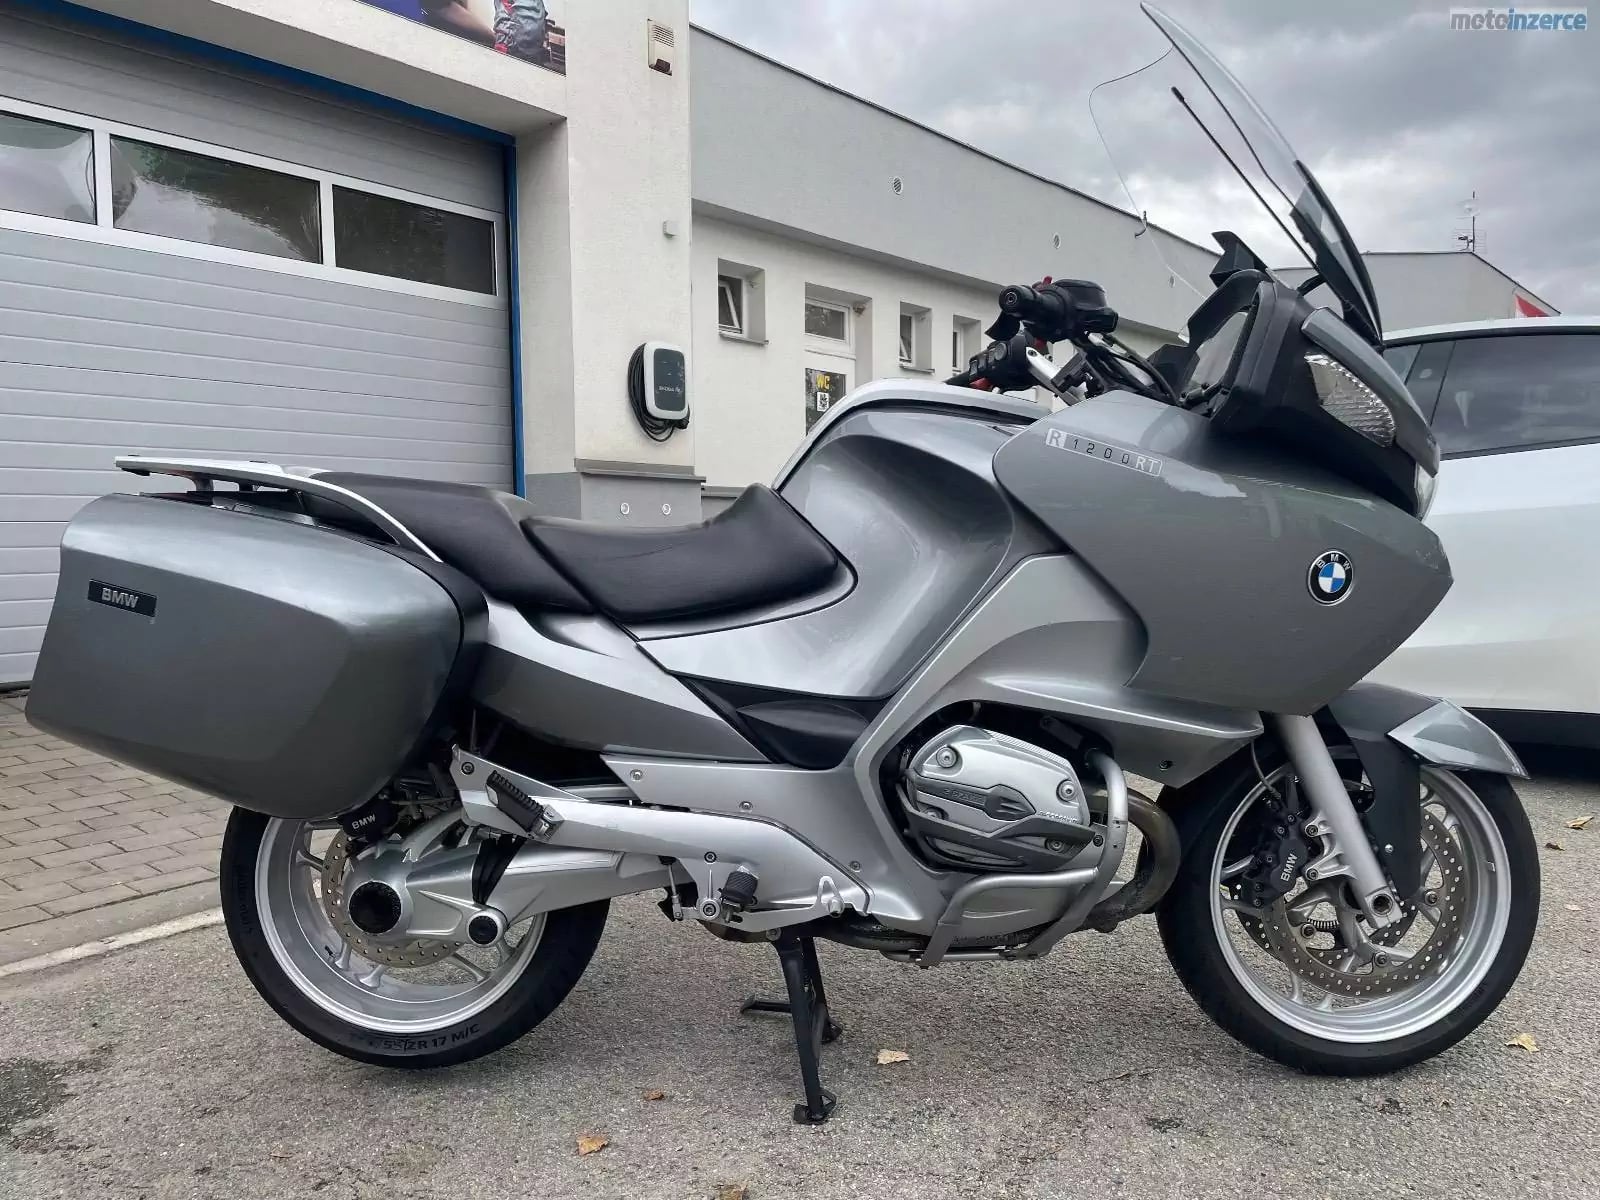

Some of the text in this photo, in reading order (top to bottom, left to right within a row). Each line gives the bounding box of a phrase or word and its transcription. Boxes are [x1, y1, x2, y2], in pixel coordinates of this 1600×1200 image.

[101, 587, 139, 608] BMW
[351, 813, 376, 830] BMW
[1280, 853, 1298, 882] BMW
